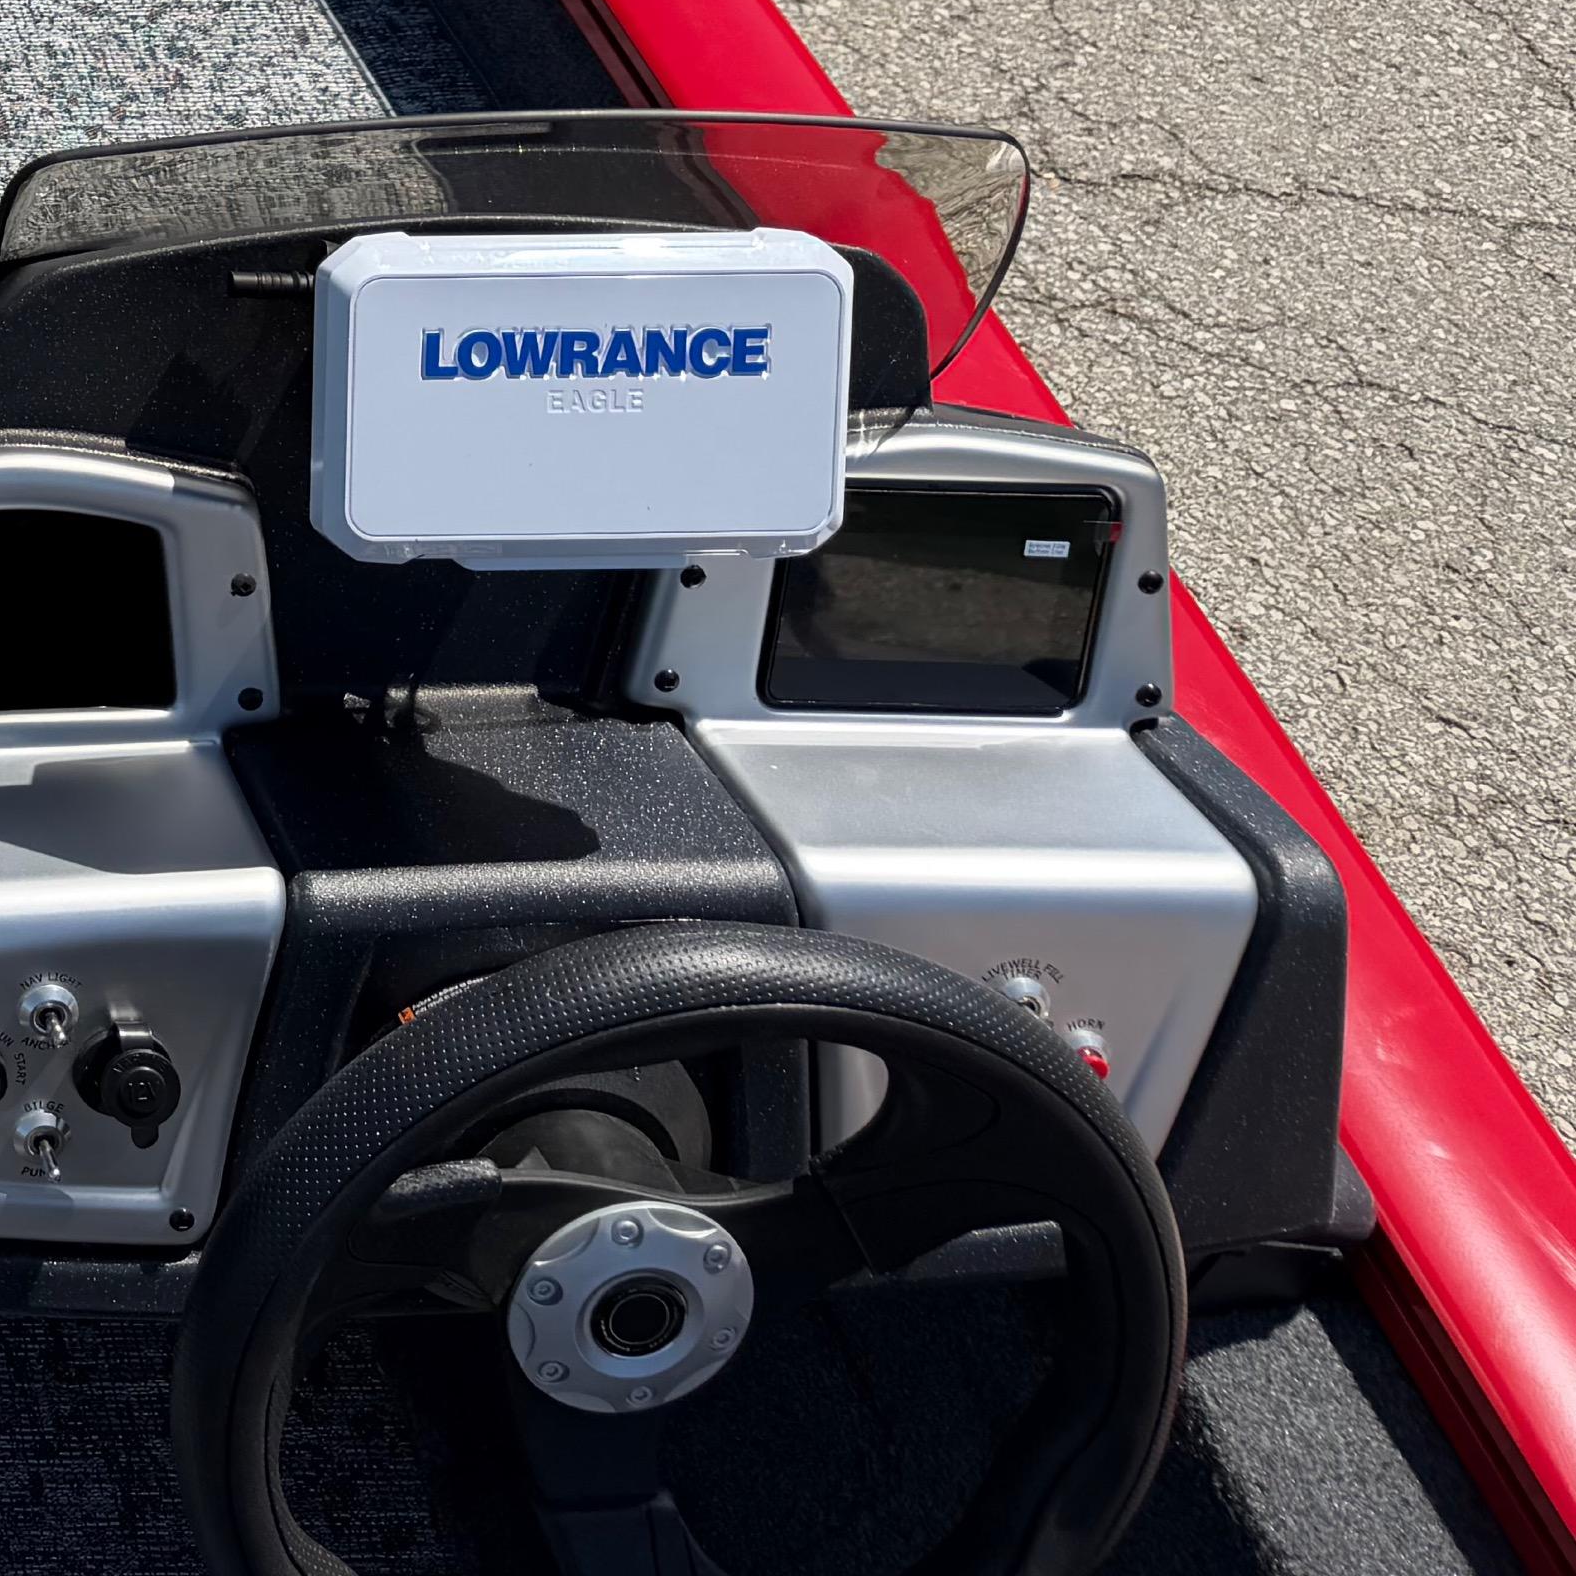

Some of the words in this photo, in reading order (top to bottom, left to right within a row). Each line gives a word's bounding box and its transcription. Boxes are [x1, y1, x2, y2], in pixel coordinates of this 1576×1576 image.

[423, 326, 770, 379] LOWRANCE
[547, 389, 645, 414] EAGLE
[19, 973, 43, 991] NAV
[47, 972, 82, 989] LIGHT
[981, 958, 1041, 982] LIVEWELL
[1043, 963, 1064, 984] FILL
[1002, 965, 1043, 981] TIMER
[1067, 1018, 1105, 1032] HORN
[14, 1052, 26, 1085] START
[23, 1100, 64, 1113] BILGE
